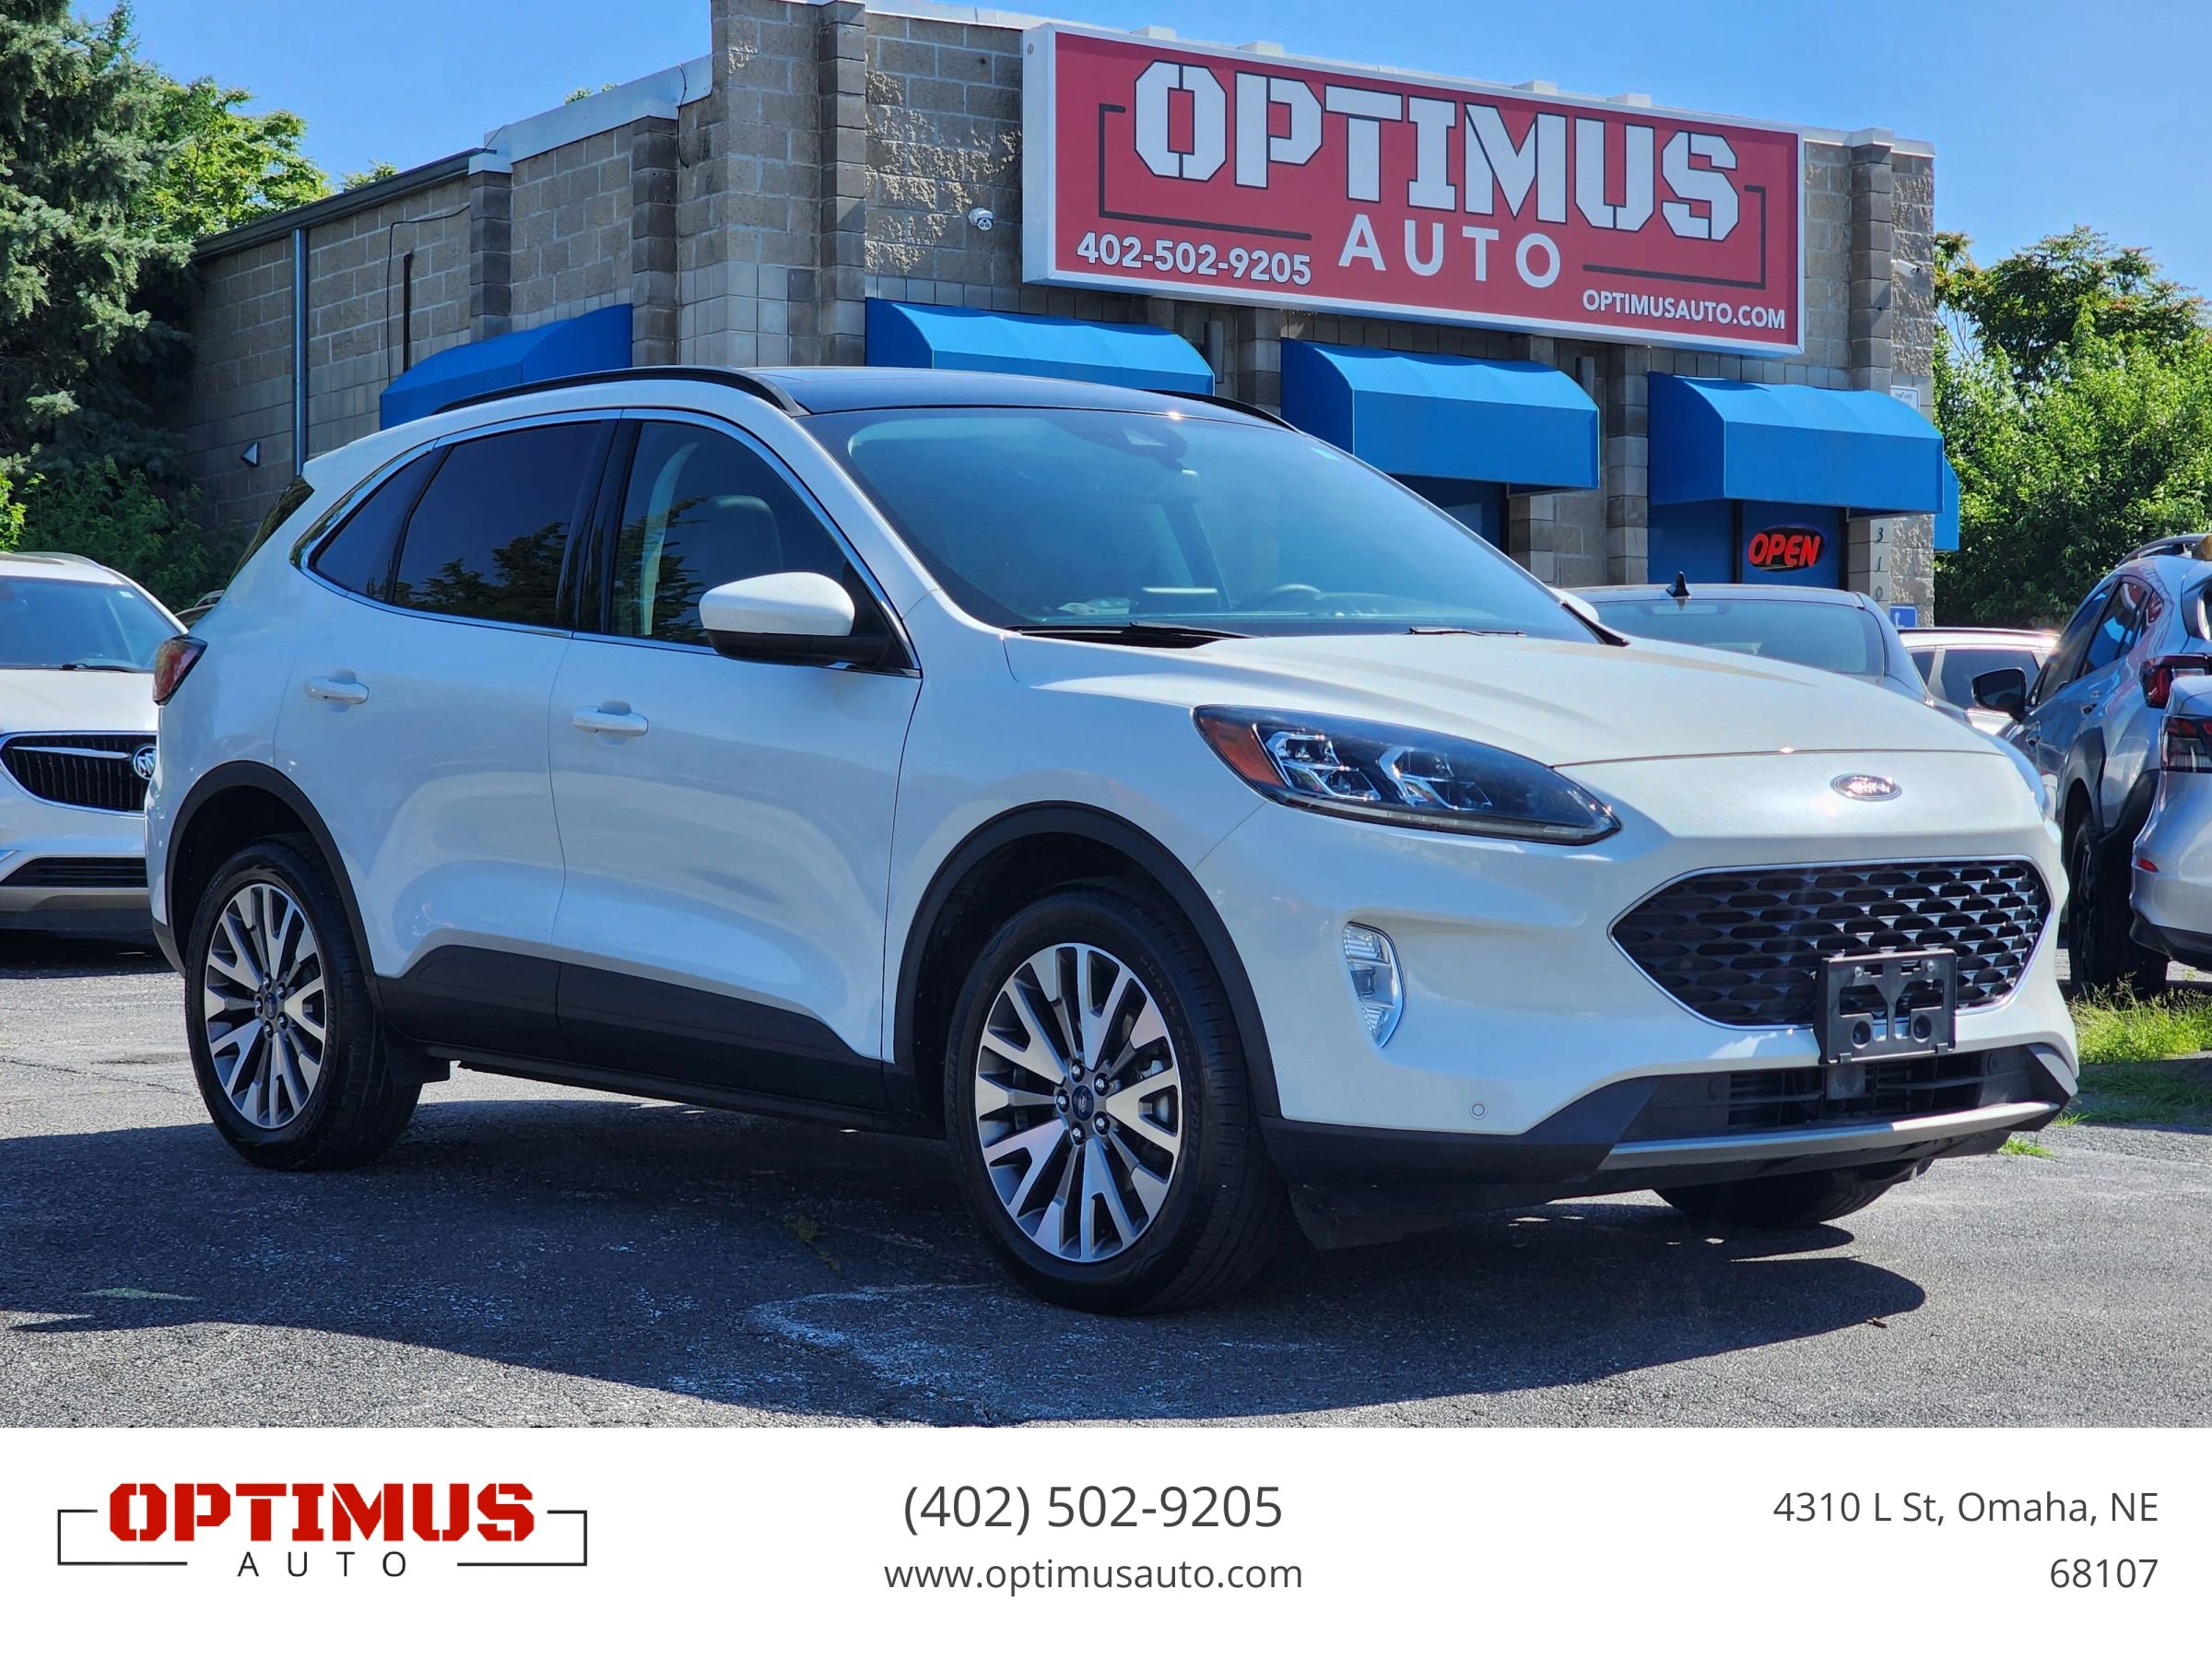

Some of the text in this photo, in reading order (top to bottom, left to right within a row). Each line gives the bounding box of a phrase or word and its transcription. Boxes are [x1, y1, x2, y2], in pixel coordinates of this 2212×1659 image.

[1135, 60, 1740, 241] OPTIMUS
[1077, 231, 1312, 287] 402-502-9205
[1338, 213, 1561, 288] AUTO
[1583, 289, 1786, 330] OPTIMUSAUTO.COM
[1748, 534, 1821, 566] OPEN
